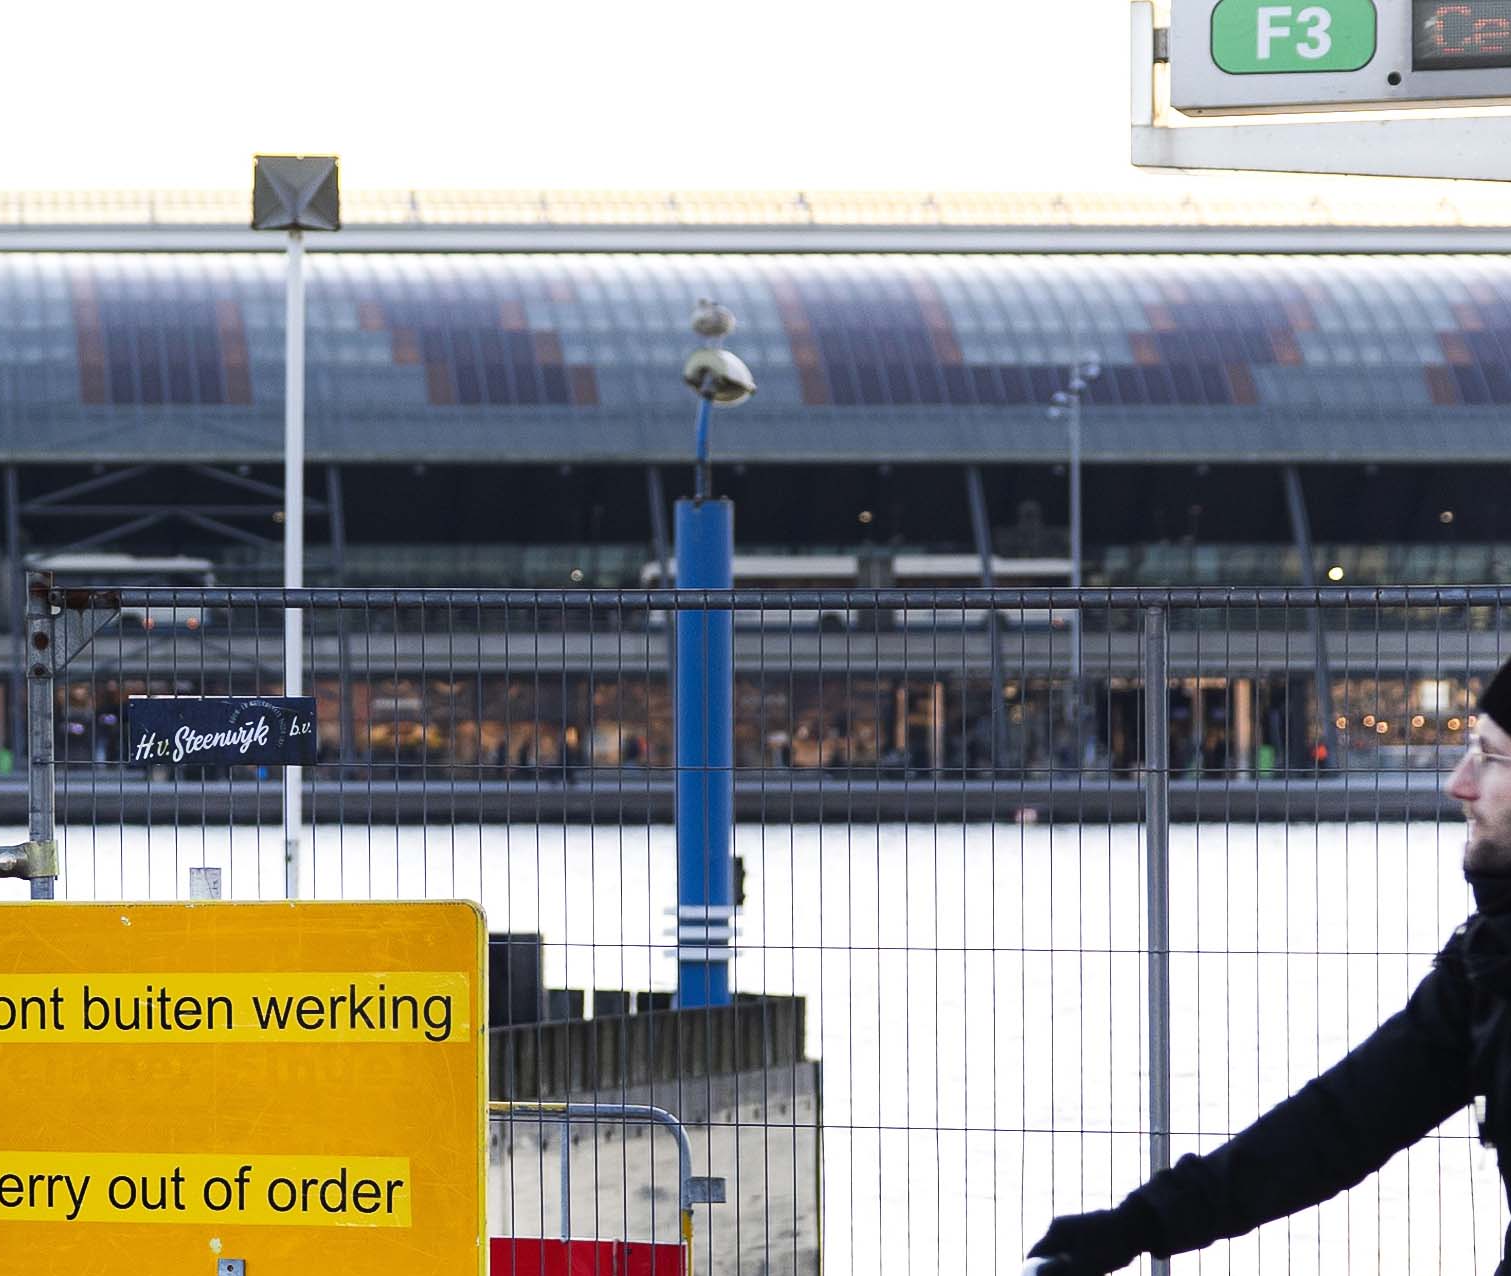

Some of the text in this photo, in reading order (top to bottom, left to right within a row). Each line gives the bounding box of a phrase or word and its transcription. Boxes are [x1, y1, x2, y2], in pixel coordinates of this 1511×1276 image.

[1256, 6, 1332, 60] F3
[172, 716, 270, 763] Steenwijk
[289, 715, 312, 737] b.v.
[83, 985, 234, 1031] buiten
[252, 983, 453, 1041] werking
[108, 1167, 186, 1211] out
[203, 1165, 252, 1211] of
[267, 1167, 404, 1214] order
